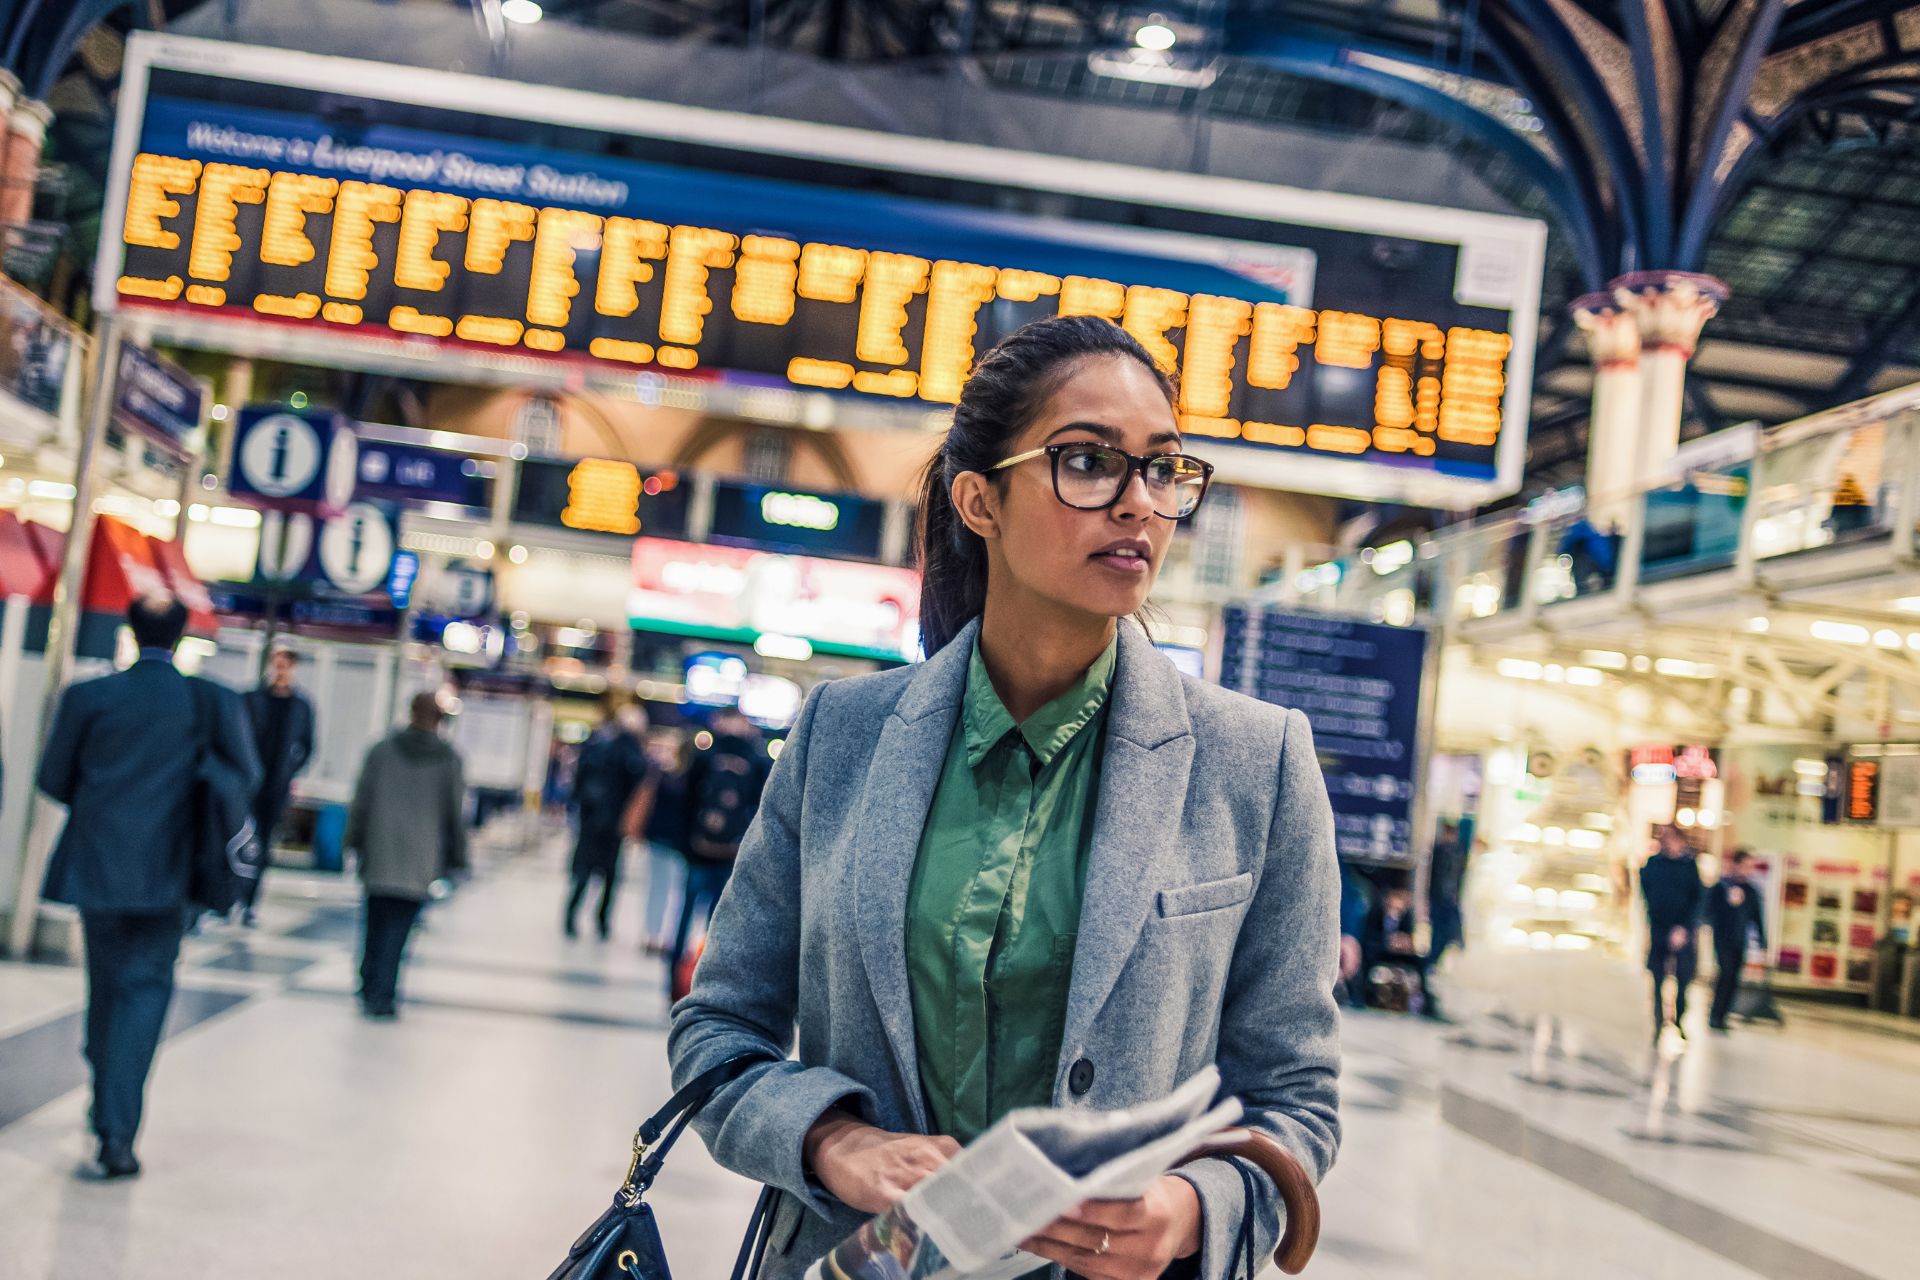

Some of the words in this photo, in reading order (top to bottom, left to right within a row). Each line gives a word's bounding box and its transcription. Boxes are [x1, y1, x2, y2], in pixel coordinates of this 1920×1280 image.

[312, 134, 444, 183] Liverpool
[440, 152, 526, 196] Street
[525, 164, 629, 208] Station
